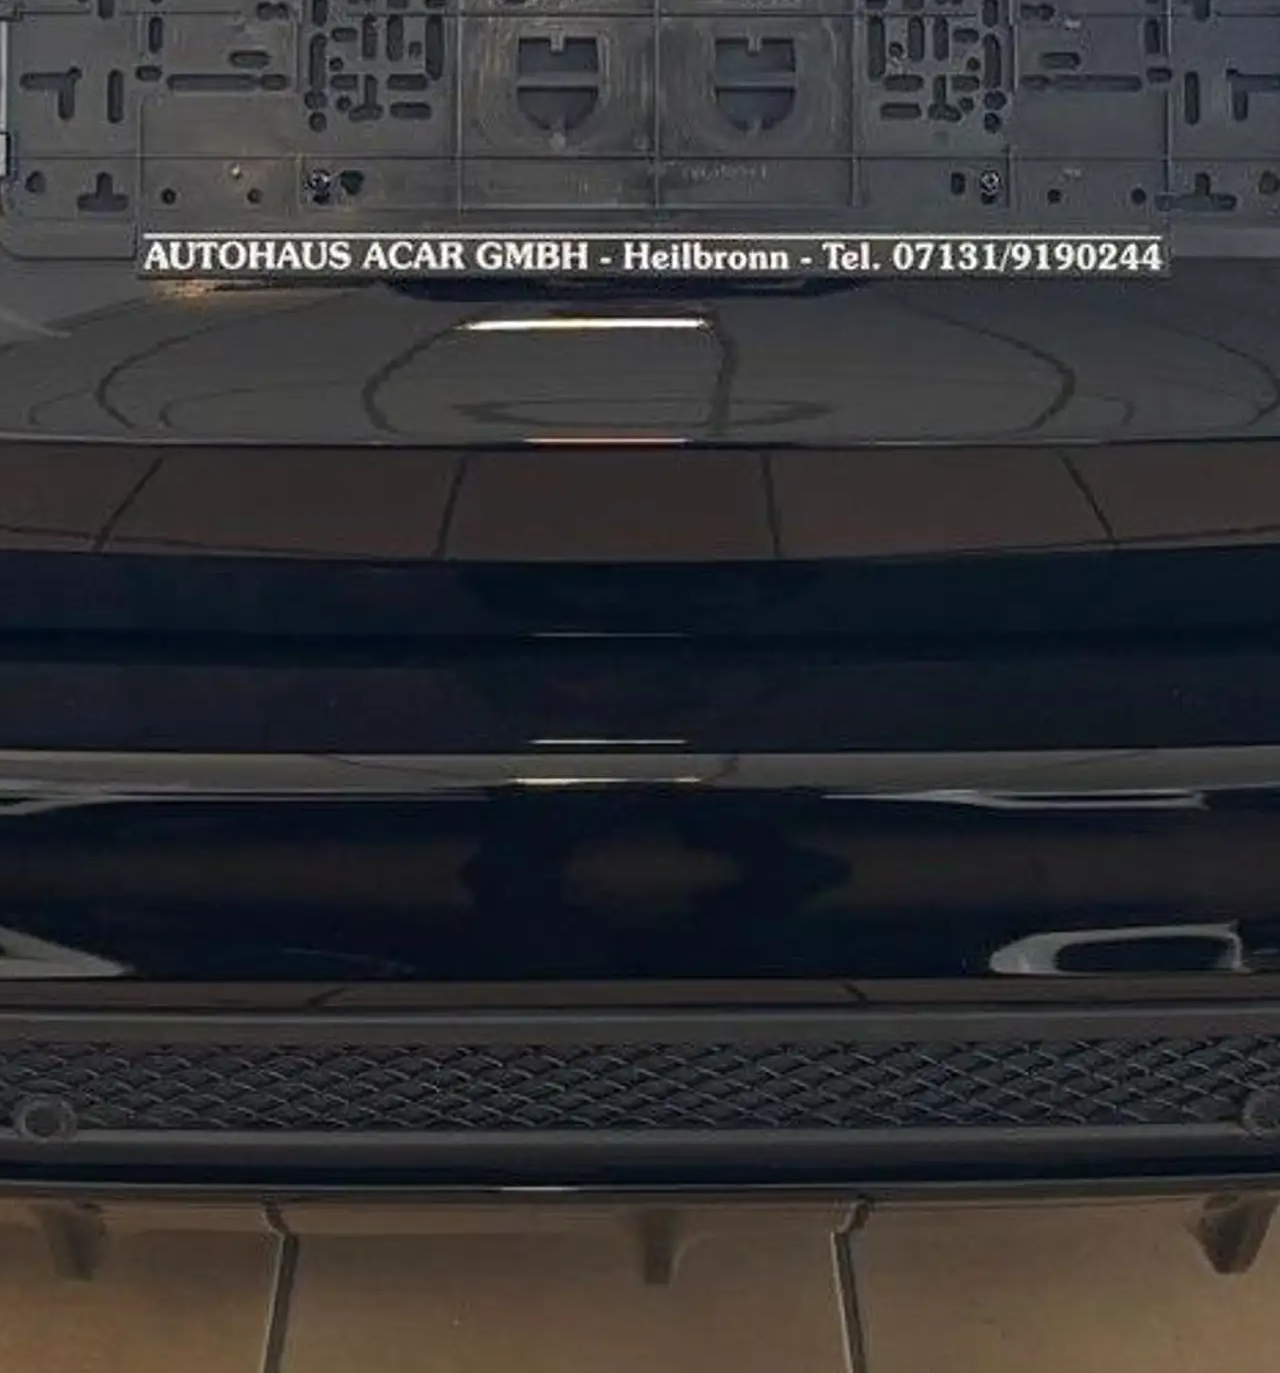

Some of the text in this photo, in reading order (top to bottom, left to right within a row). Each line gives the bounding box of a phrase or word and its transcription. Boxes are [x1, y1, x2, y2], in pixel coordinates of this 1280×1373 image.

[144, 240, 352, 271] AUTOHAUS
[362, 240, 466, 271] ACAR
[476, 240, 588, 271] GMBH
[623, 240, 790, 272] Heilbronn
[821, 240, 881, 272] Tel.
[892, 240, 1164, 273] 07131/9190244
